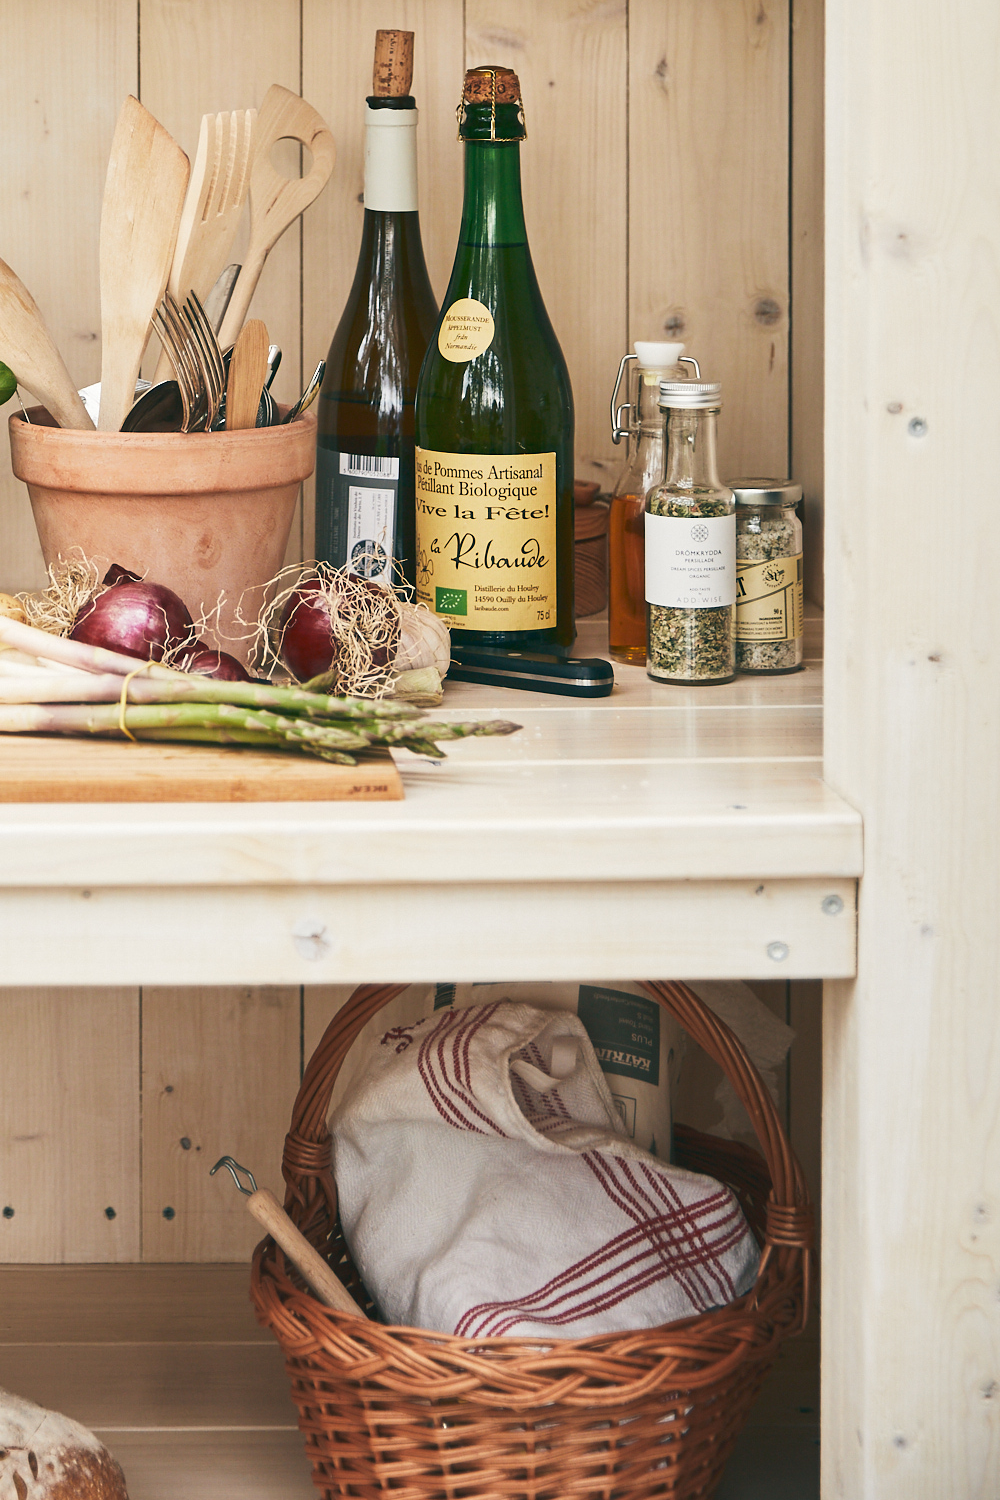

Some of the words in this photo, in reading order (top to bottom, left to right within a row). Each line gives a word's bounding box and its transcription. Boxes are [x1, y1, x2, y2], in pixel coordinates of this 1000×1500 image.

[454, 333, 468, 342] från
[445, 342, 478, 350] Normandie
[423, 459, 433, 475] de
[434, 462, 483, 480] Pommes
[487, 463, 543, 480] Artisanal
[417, 475, 454, 495] Pétillant
[459, 481, 538, 501] Biologique
[416, 497, 447, 516] Vive
[454, 504, 476, 520] la
[485, 504, 550, 521] Fête!
[444, 532, 549, 570] Ribaude
[474, 584, 506, 592] Distillerie
[517, 584, 539, 593] Houley
[474, 595, 494, 603] 14590
[495, 595, 516, 604] Ouilly
[517, 595, 526, 603] du
[527, 594, 548, 603] Houley
[537, 610, 544, 620] 75
[631, 1033, 653, 1047] PLUS
